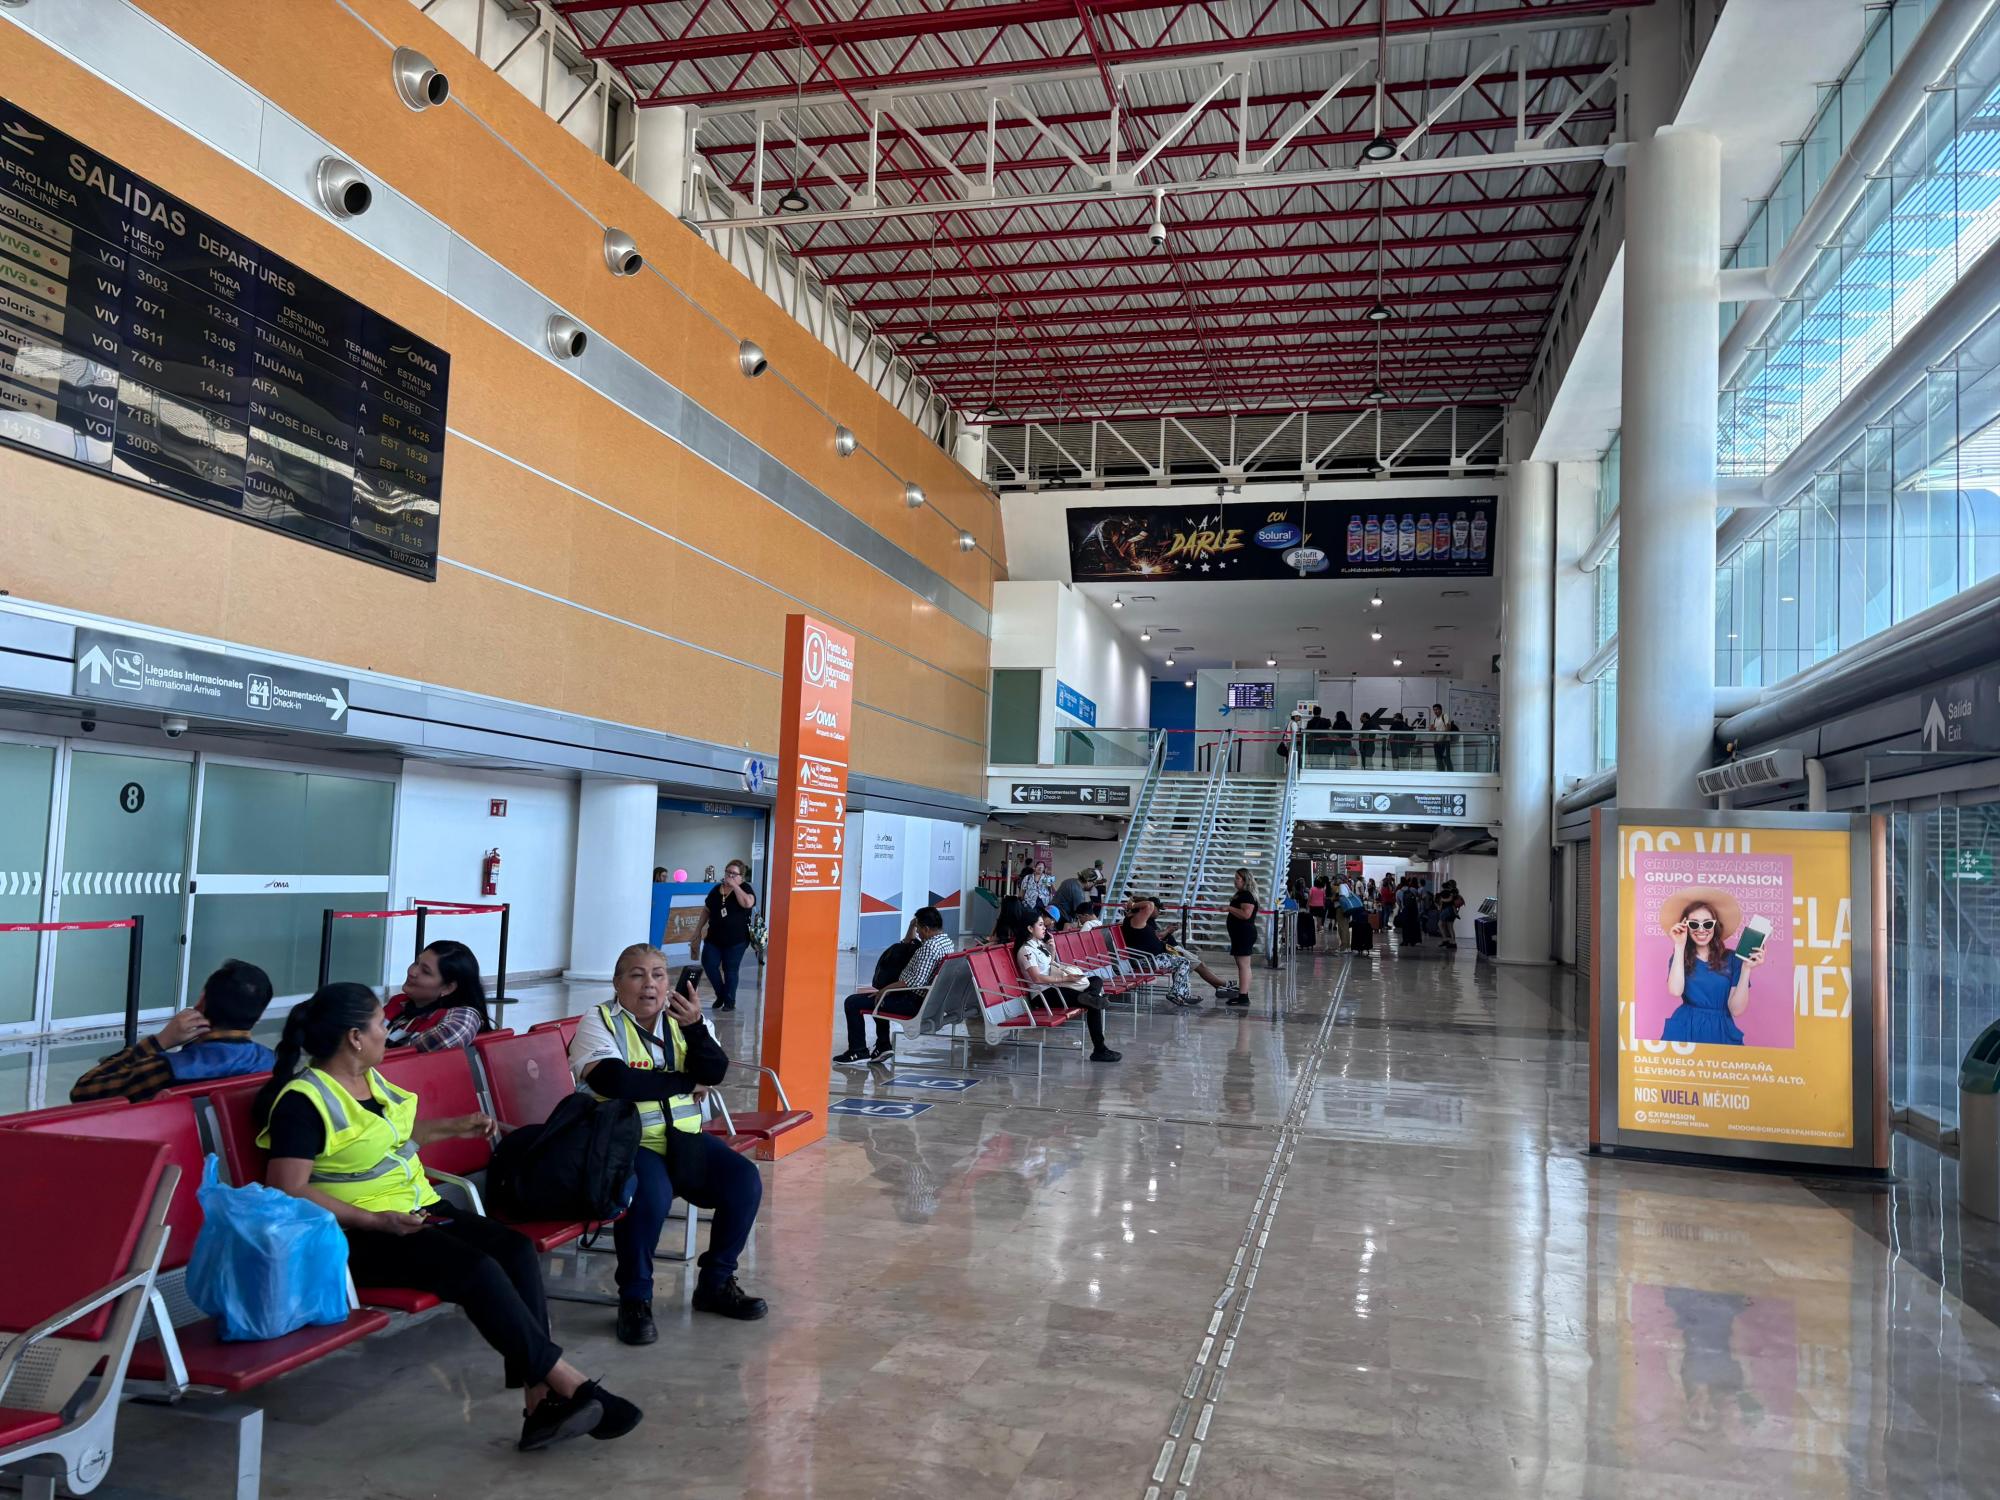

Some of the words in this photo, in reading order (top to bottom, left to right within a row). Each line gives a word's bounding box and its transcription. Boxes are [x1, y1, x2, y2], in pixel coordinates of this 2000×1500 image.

[12, 179, 60, 209] AIRLINE
[68, 153, 187, 237] SALIDAS
[199, 233, 297, 297] DEPARTURES
[121, 220, 165, 251] VUELO
[123, 236, 162, 261] FLIGHT
[209, 268, 240, 292] HORA
[214, 282, 235, 300] TIME
[99, 248, 125, 271] VOI
[137, 269, 168, 292] 3003
[207, 303, 239, 328] 12:34
[255, 326, 304, 359] TIJUANA
[360, 380, 369, 391] A
[384, 390, 421, 416] CLOSED
[277, 314, 329, 347] DESTINATION
[283, 306, 325, 335] DESTINO
[97, 277, 121, 298] VIV
[135, 296, 166, 319] 7071
[203, 329, 236, 352] 13:05
[254, 352, 304, 384] TIJUANA
[359, 403, 367, 414] A
[382, 414, 399, 430] EST
[344, 339, 388, 368] TERMINAL
[408, 351, 438, 375] OMA
[0, 295, 36, 318] olaris
[92, 333, 118, 354] VOI
[131, 350, 163, 373] 7476
[199, 381, 231, 402] 14:41
[250, 401, 266, 417] SN
[269, 409, 299, 431] JOSE
[302, 425, 324, 442] DEL
[326, 435, 349, 452] CAB
[356, 447, 364, 458] A
[379, 457, 397, 472] EST
[94, 305, 119, 325] VIV
[133, 324, 164, 346] 9511
[201, 355, 234, 377] 14:15
[251, 377, 279, 398] AIFA
[357, 425, 365, 436] A
[381, 435, 398, 451] EST
[397, 367, 432, 391] ESTATUS
[402, 380, 427, 398] STATUS
[88, 391, 114, 411] VOI
[127, 406, 158, 428] 7181
[248, 453, 275, 472] AIFA
[353, 493, 361, 504] A
[85, 418, 111, 438] VOI
[126, 434, 159, 454] 3005
[195, 460, 227, 480] 17:45
[246, 476, 295, 502] TIJUANA
[351, 515, 359, 526] A
[375, 523, 393, 537] EST
[1258, 531, 1292, 540] Solural
[144, 676, 193, 691] International
[194, 684, 221, 697] Arrivals
[145, 664, 183, 680] Llegadas
[185, 668, 243, 690] Internacionales
[272, 698, 302, 710] Check-in
[273, 686, 327, 703] Documentación
[816, 710, 837, 728] OMA
[1948, 699, 1972, 721] Salida
[1948, 726, 1962, 742] Exit
[126, 785, 139, 810] 8
[273, 881, 290, 889] OMA
[1644, 872, 1693, 883] GRUPO
[1633, 1055, 1659, 1065] DALE
[1661, 1057, 1696, 1067] VUELO
[1696, 1059, 1705, 1067] A
[1705, 1059, 1720, 1068] TU
[1721, 1060, 1773, 1072] CAMPAÑA
[1633, 1066, 1687, 1077] LLEVEMOS
[1687, 1069, 1697, 1078] A
[1698, 1070, 1711, 1079] TU
[1712, 1071, 1751, 1081] MARCA
[1752, 1072, 1777, 1084] MÁS
[1634, 1087, 1658, 1103] NOS
[1660, 1089, 1700, 1106] VUELA
[1702, 1089, 1750, 1110] MÉXICO
